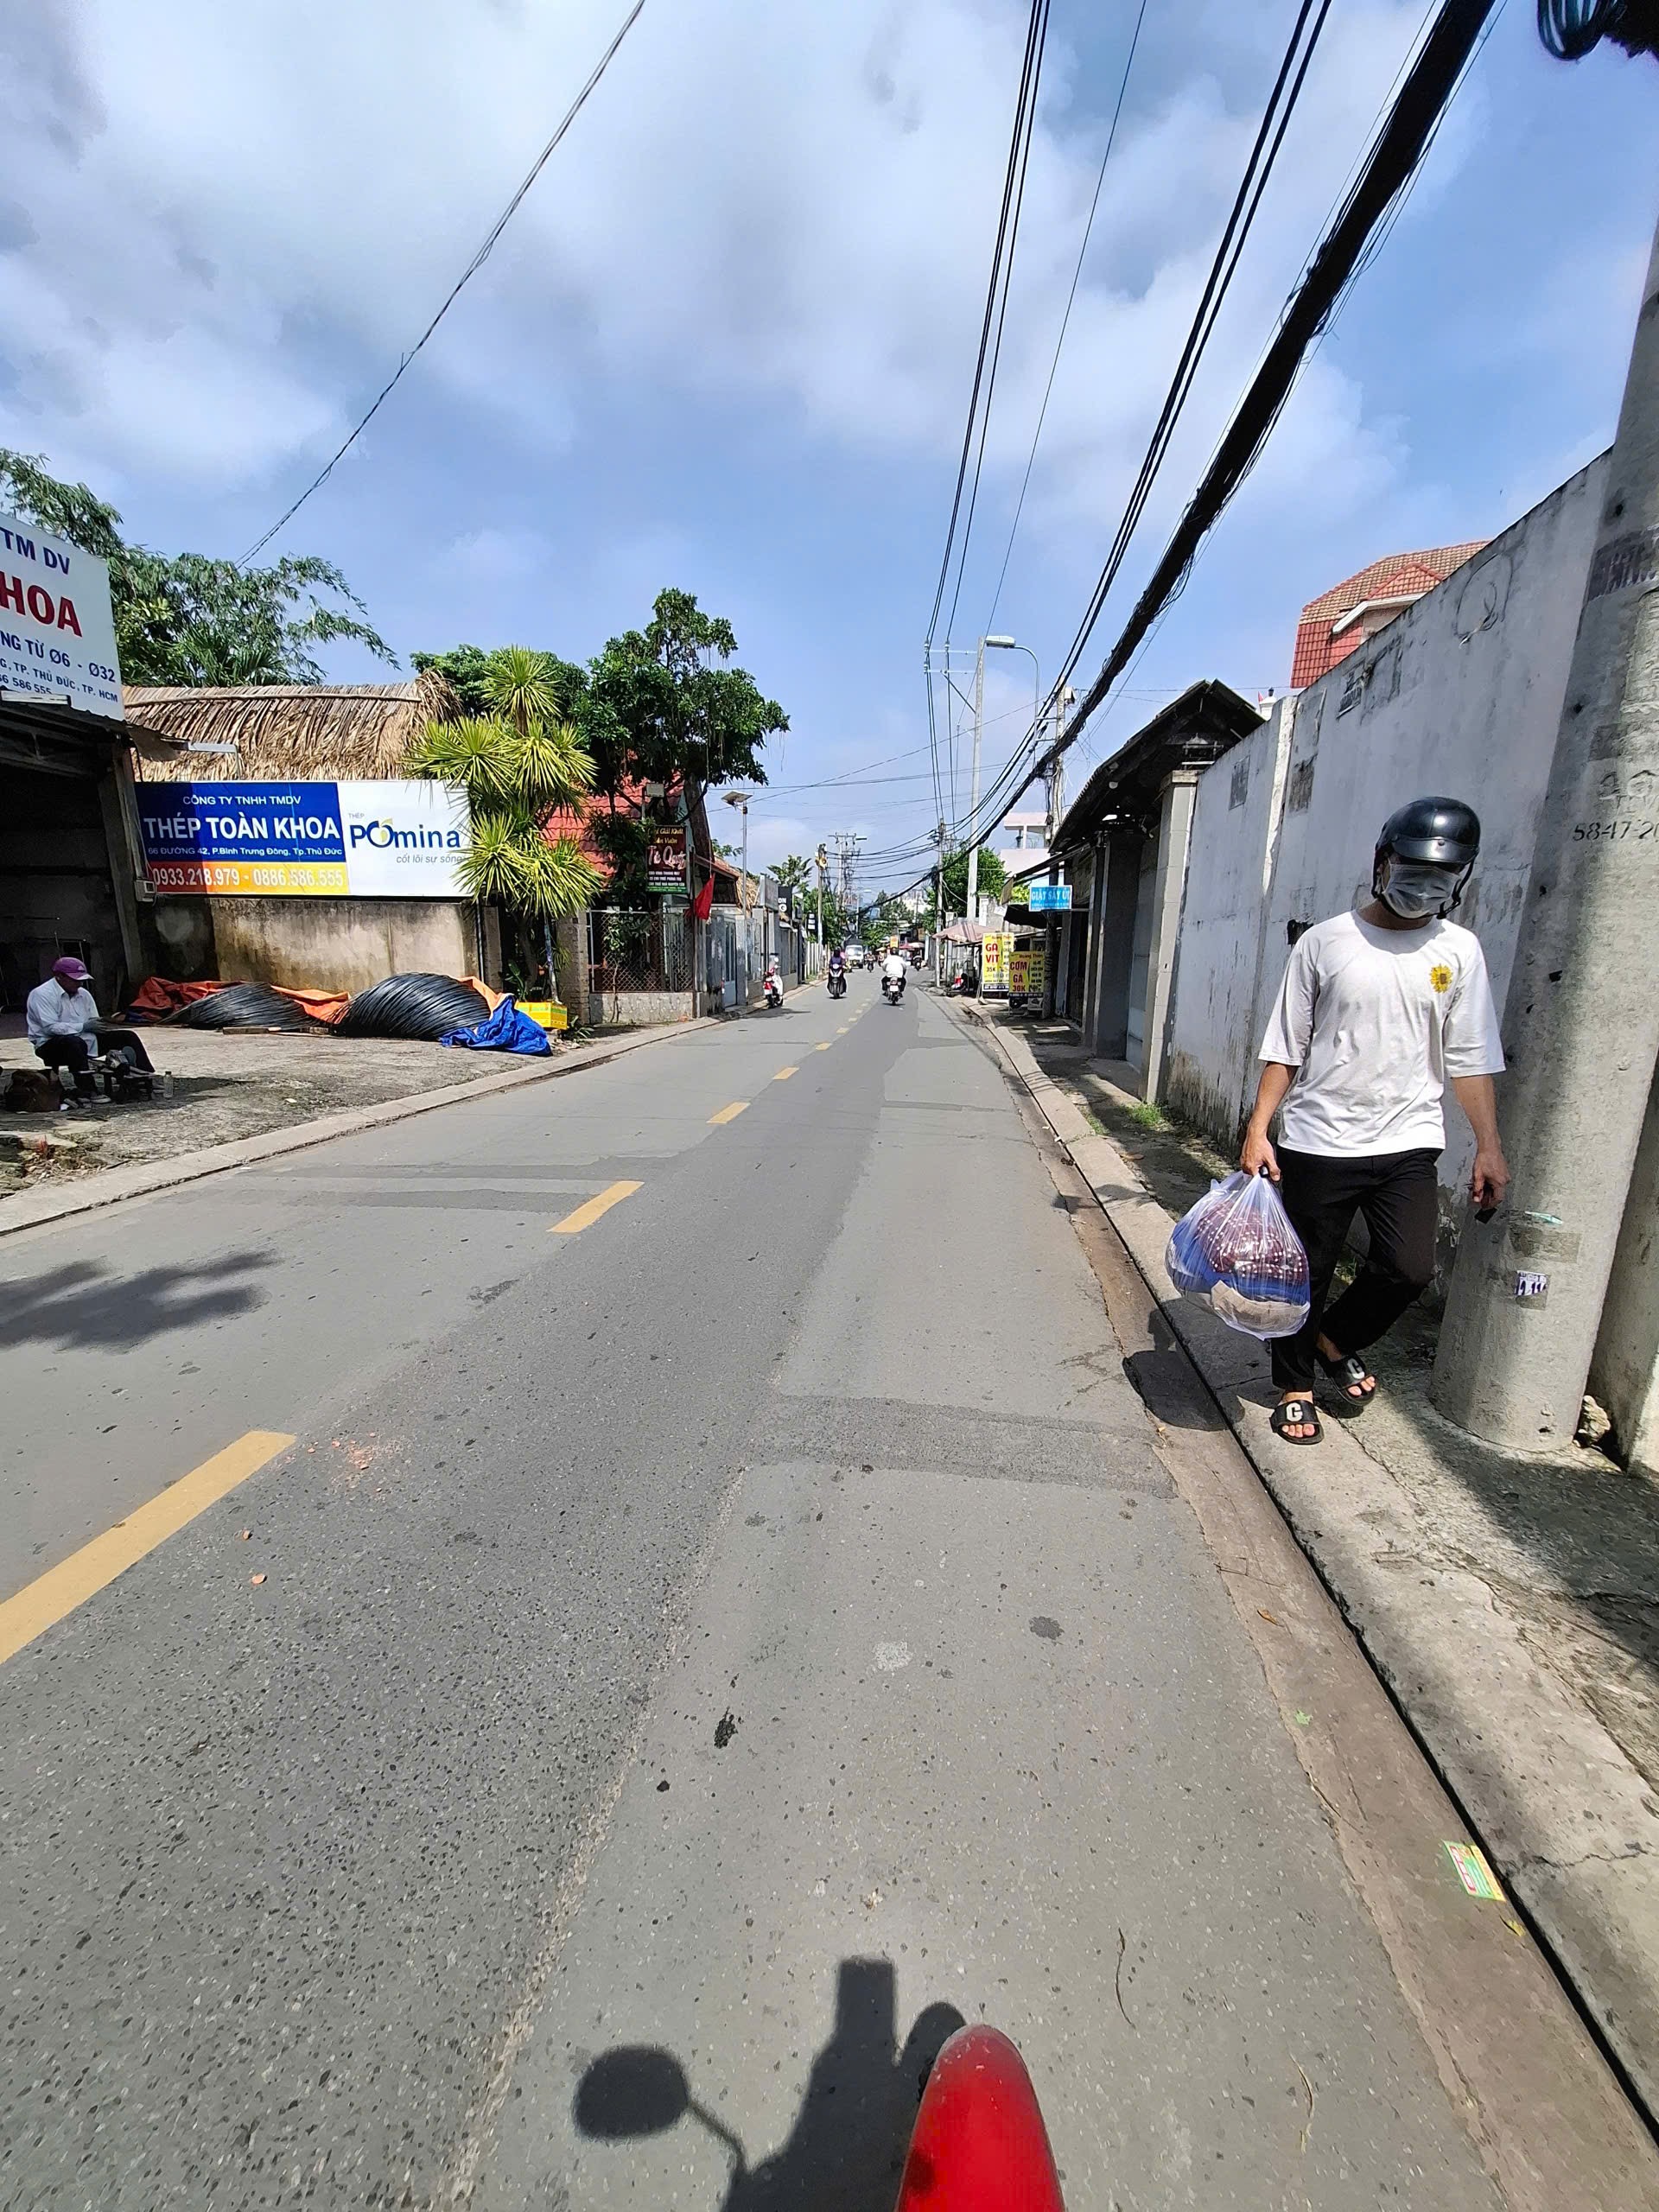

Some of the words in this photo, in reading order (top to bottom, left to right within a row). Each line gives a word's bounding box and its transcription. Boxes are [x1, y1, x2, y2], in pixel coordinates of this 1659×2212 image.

[0, 526, 37, 562] TM
[43, 546, 71, 575] DV
[24, 639, 45, 659] TỪ
[12, 677, 32, 691] 586
[13, 662, 30, 676] TP.
[32, 668, 53, 683] THỦ
[81, 683, 97, 696] TP.
[99, 689, 118, 703] HCM
[182, 794, 217, 805] CÔNG
[218, 795, 233, 805] TY
[235, 795, 267, 805] TNHH
[269, 795, 302, 805] TMDV
[143, 811, 201, 840] THÉP
[206, 811, 269, 840] TOÀN
[274, 817, 340, 840] KHOA
[160, 845, 195, 855] ĐƯỜNG
[239, 848, 265, 857] Trưng
[324, 846, 343, 855] Đức
[152, 868, 240, 886] 0933.218.979
